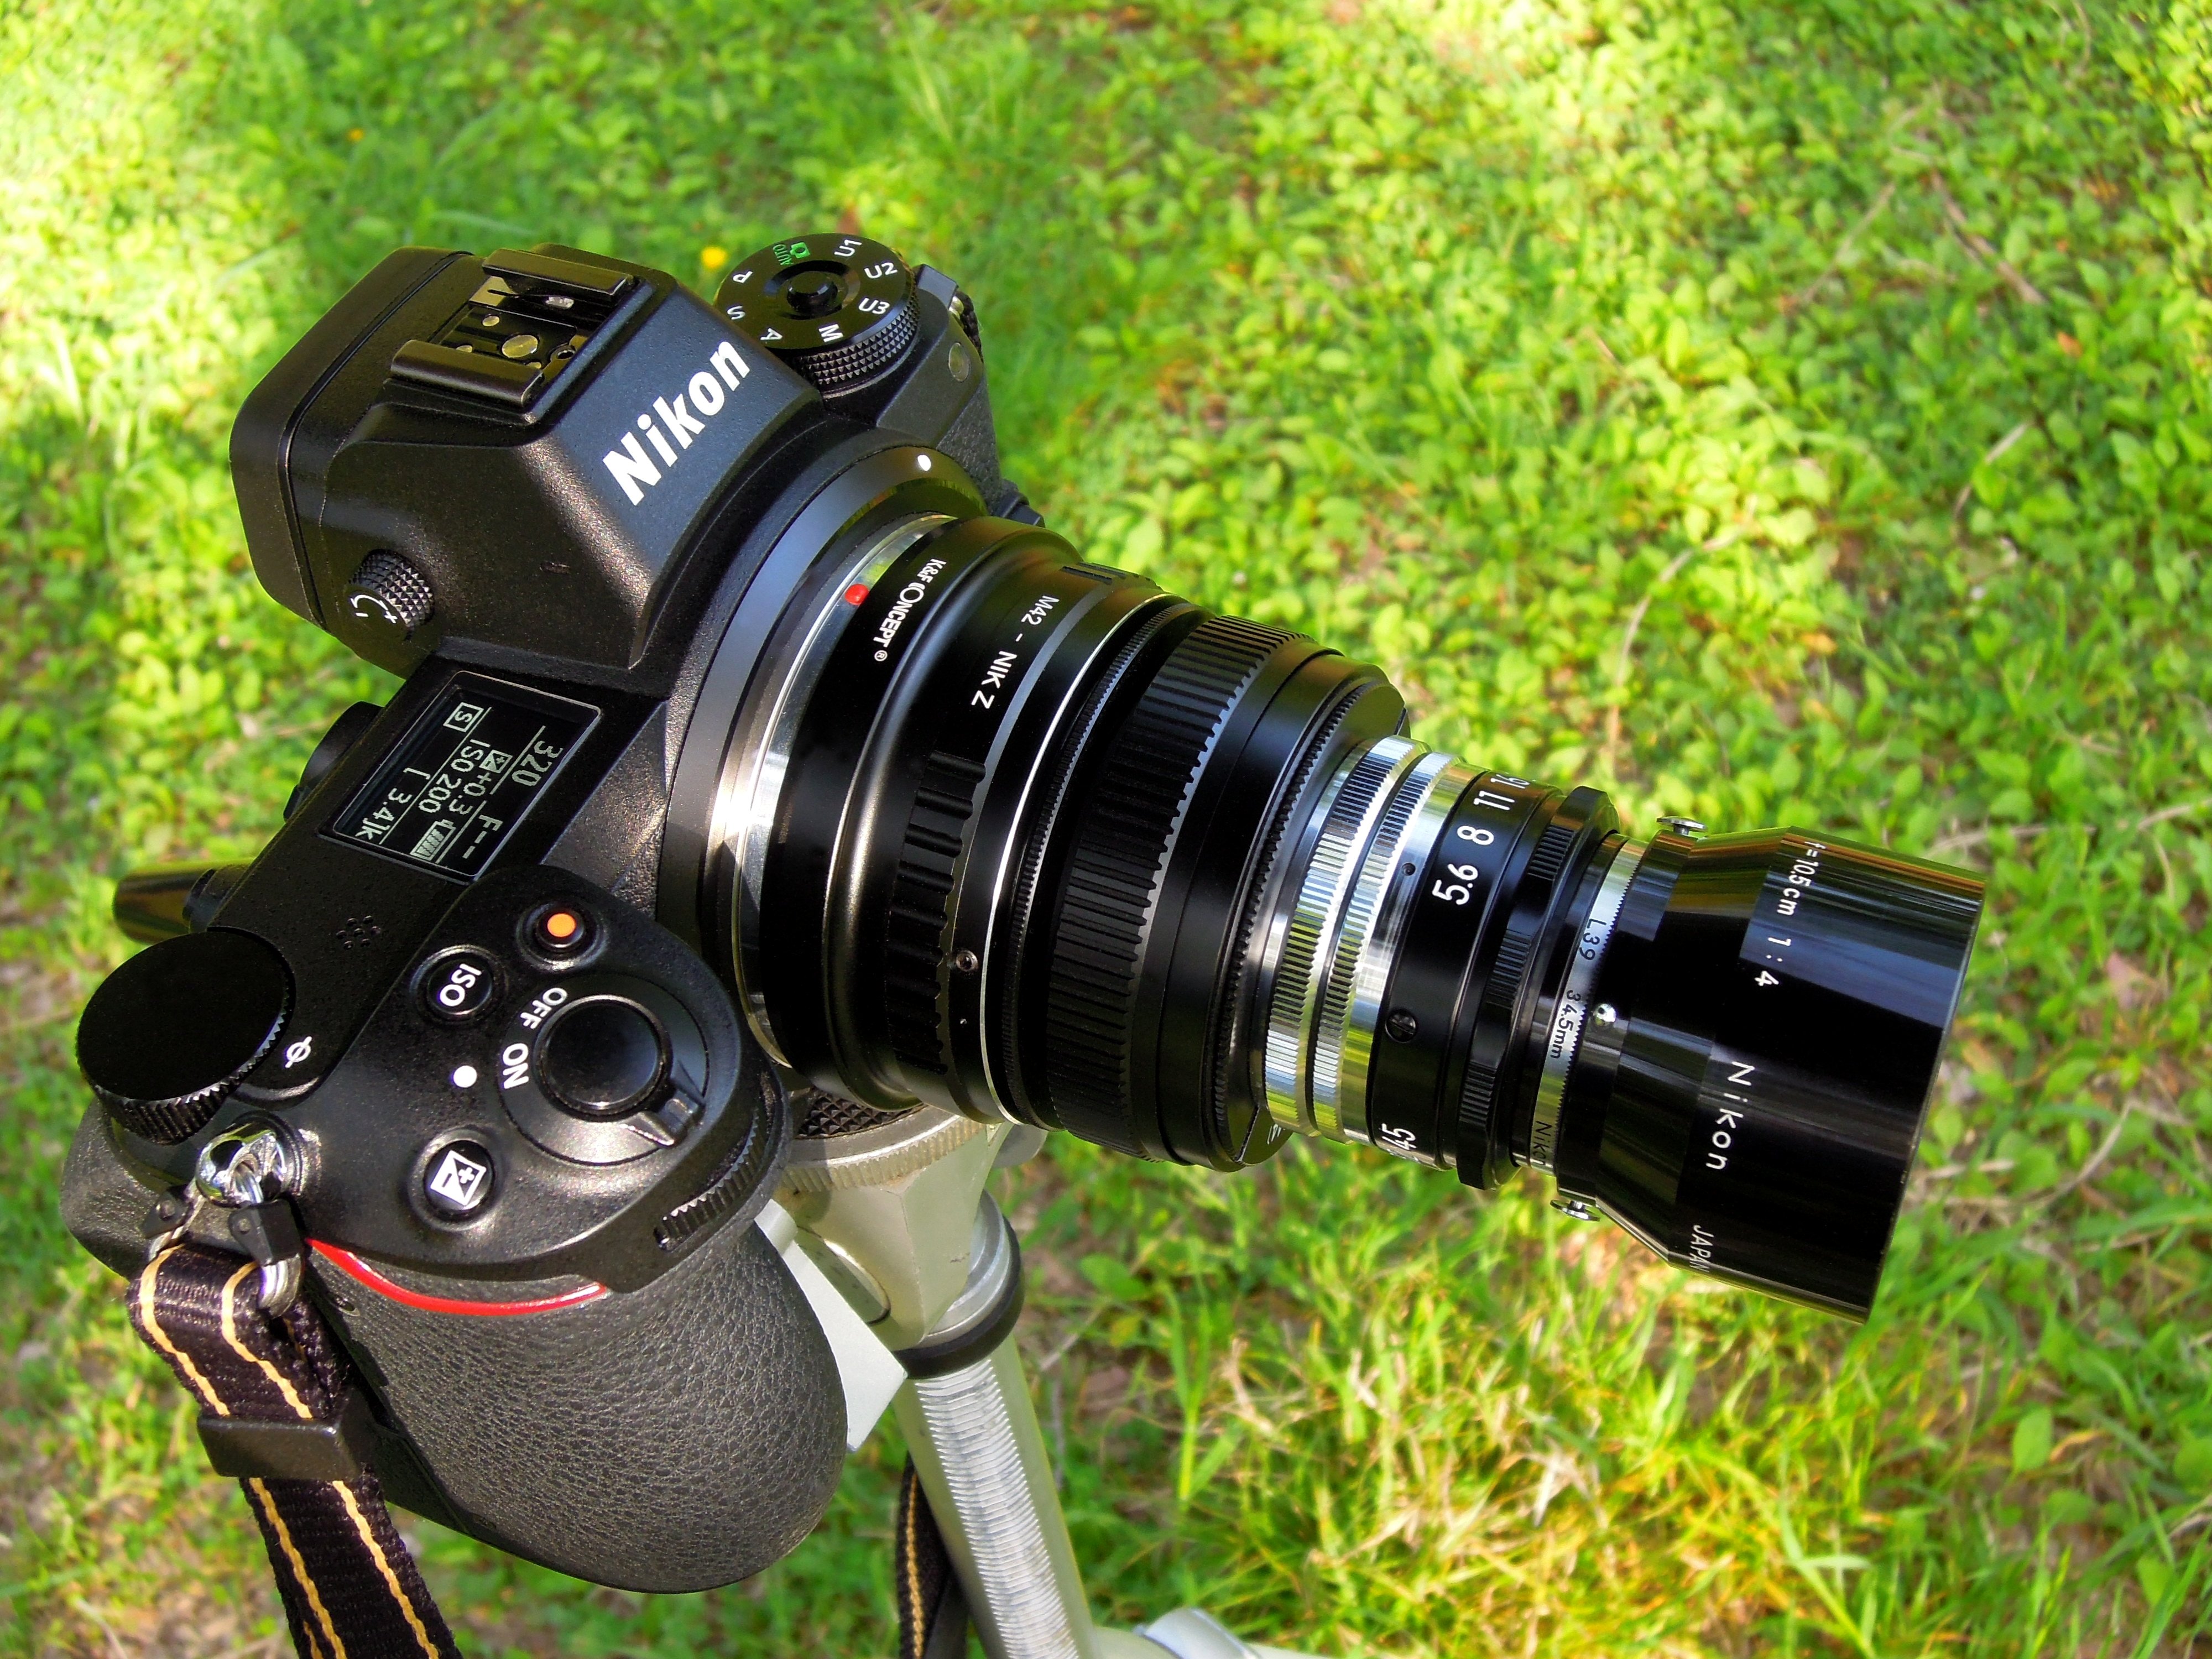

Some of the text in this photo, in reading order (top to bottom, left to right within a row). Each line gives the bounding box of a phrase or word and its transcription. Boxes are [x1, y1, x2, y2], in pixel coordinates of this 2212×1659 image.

[773, 244, 794, 265] AUTO
[834, 239, 862, 258] U1
[732, 270, 753, 284] P
[864, 262, 899, 279] U2
[727, 305, 745, 320] S
[858, 297, 890, 315] U3
[760, 328, 783, 341] A
[818, 324, 844, 342] M
[602, 341, 750, 506] Nikon
[917, 559, 947, 583] K&F
[873, 582, 926, 648] CONCEPT
[1021, 595, 1060, 625] M42
[981, 650, 1018, 688] NIK
[971, 690, 995, 709] Z
[419, 739, 491, 813] ISO 200
[512, 740, 564, 787] 320
[1490, 774, 1531, 789] 16
[1473, 791, 1515, 811] 11
[1457, 826, 1494, 846] 8
[1432, 863, 1479, 905] 5.6
[1579, 919, 1606, 961] L39
[439, 963, 483, 1007] ISO
[520, 987, 568, 1029] OFF
[503, 1042, 529, 1089] ON
[1705, 1060, 1756, 1172] Nikon
[1689, 1225, 1714, 1272] JAPAN
